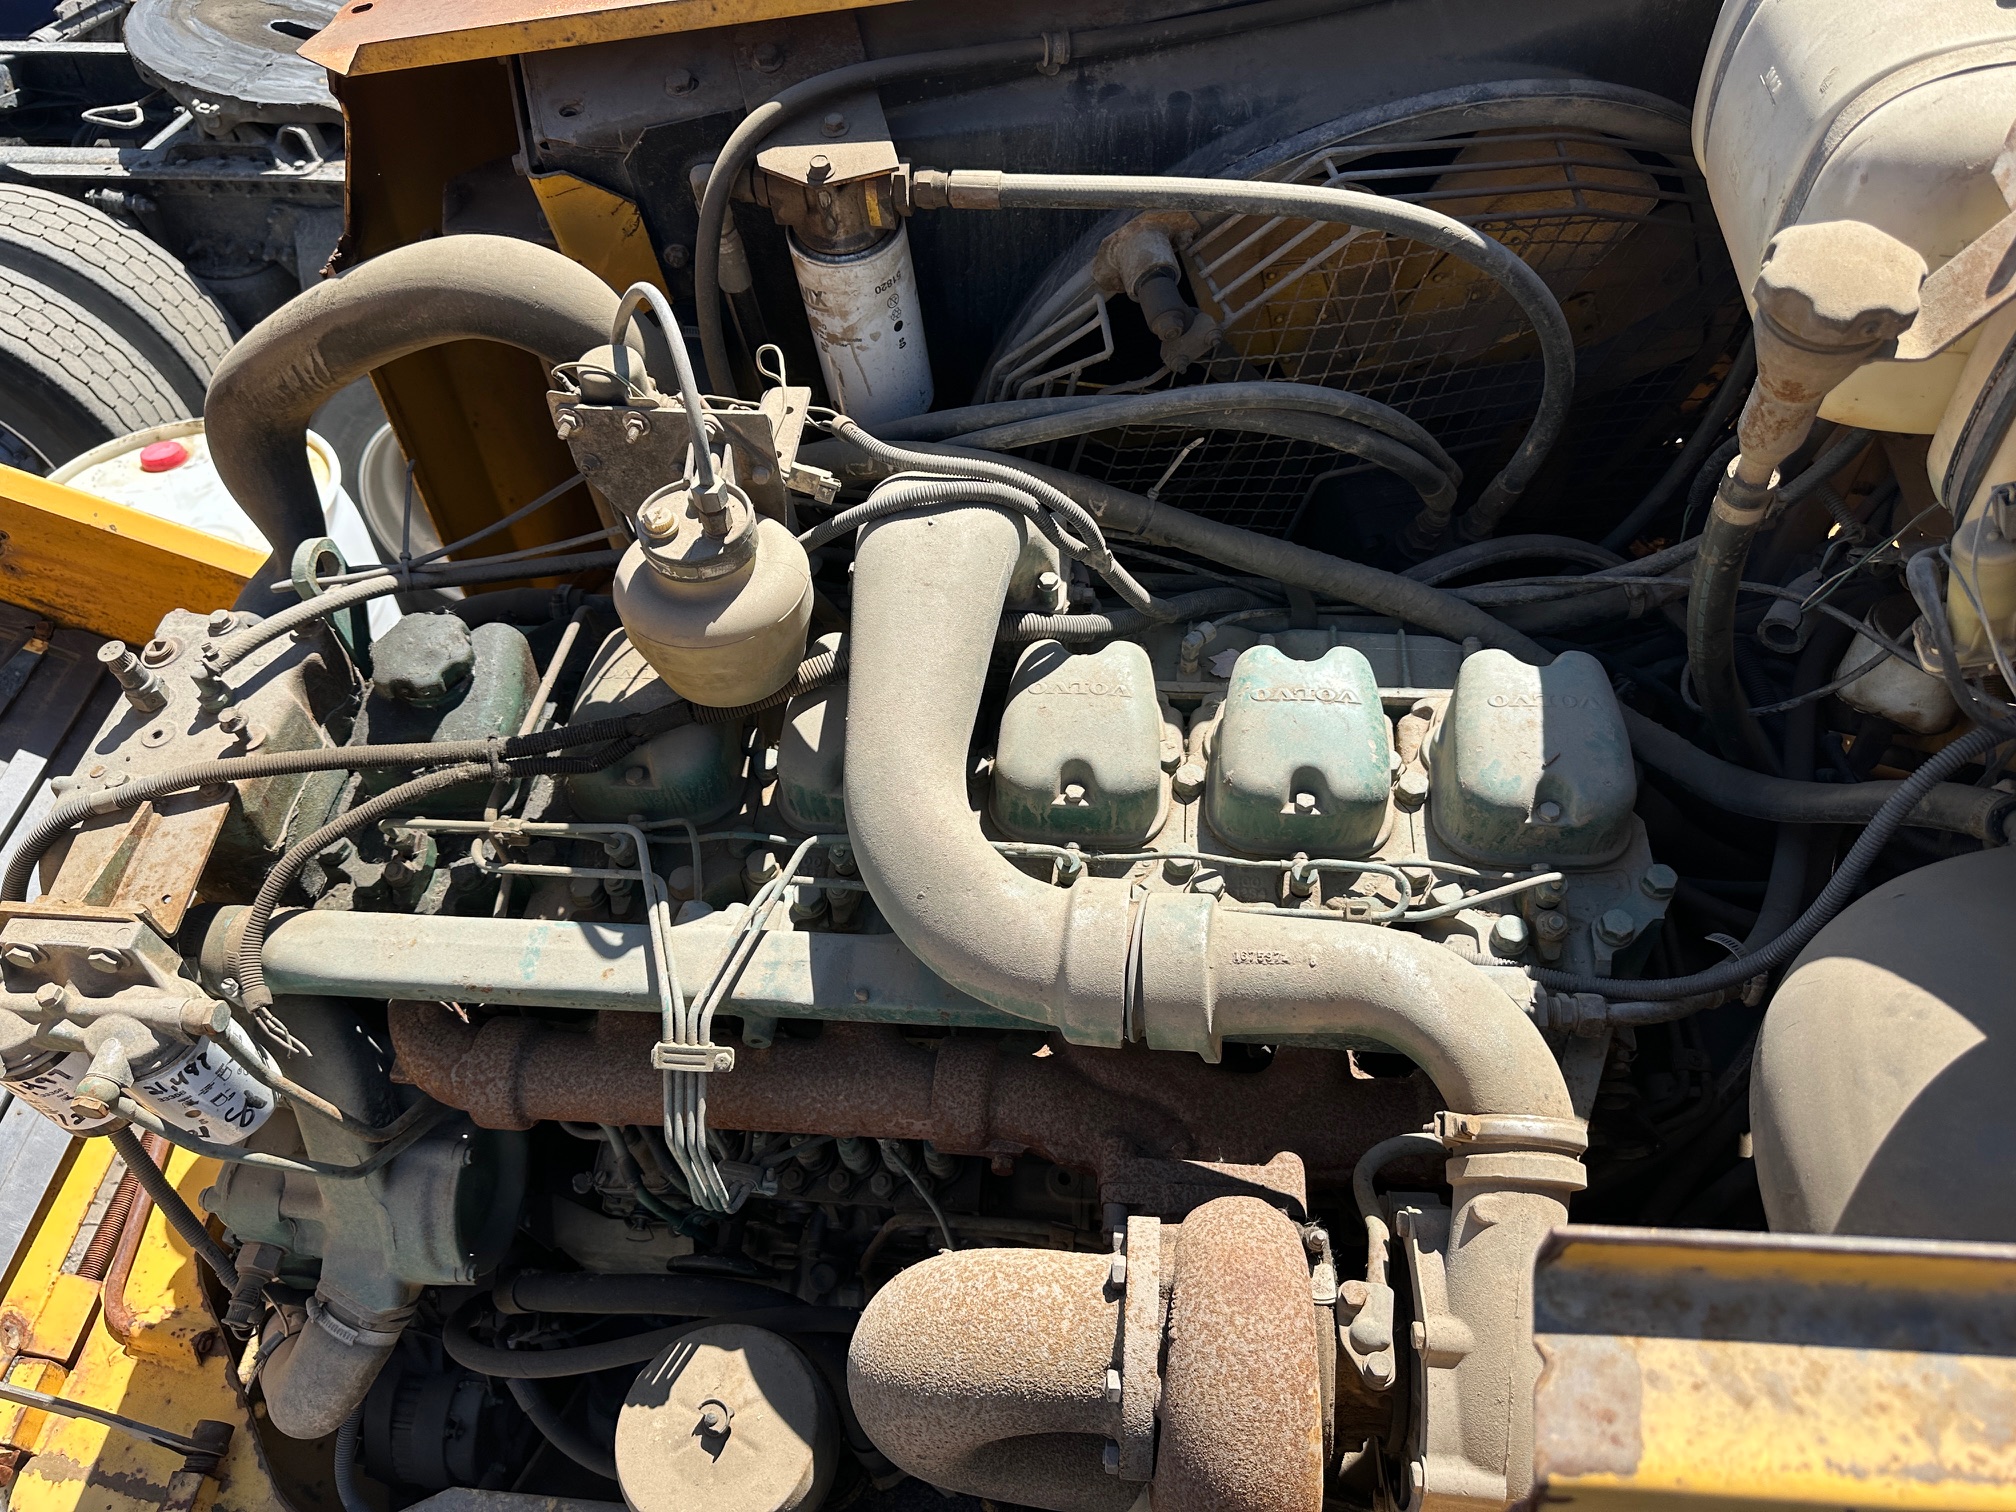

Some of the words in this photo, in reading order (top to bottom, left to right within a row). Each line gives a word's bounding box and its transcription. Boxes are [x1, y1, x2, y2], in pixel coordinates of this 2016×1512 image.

[875, 270, 902, 295] 51820
[1028, 682, 1132, 699] VOLVO
[1249, 688, 1362, 705] VOLVO
[1487, 694, 1604, 711] VOLVO
